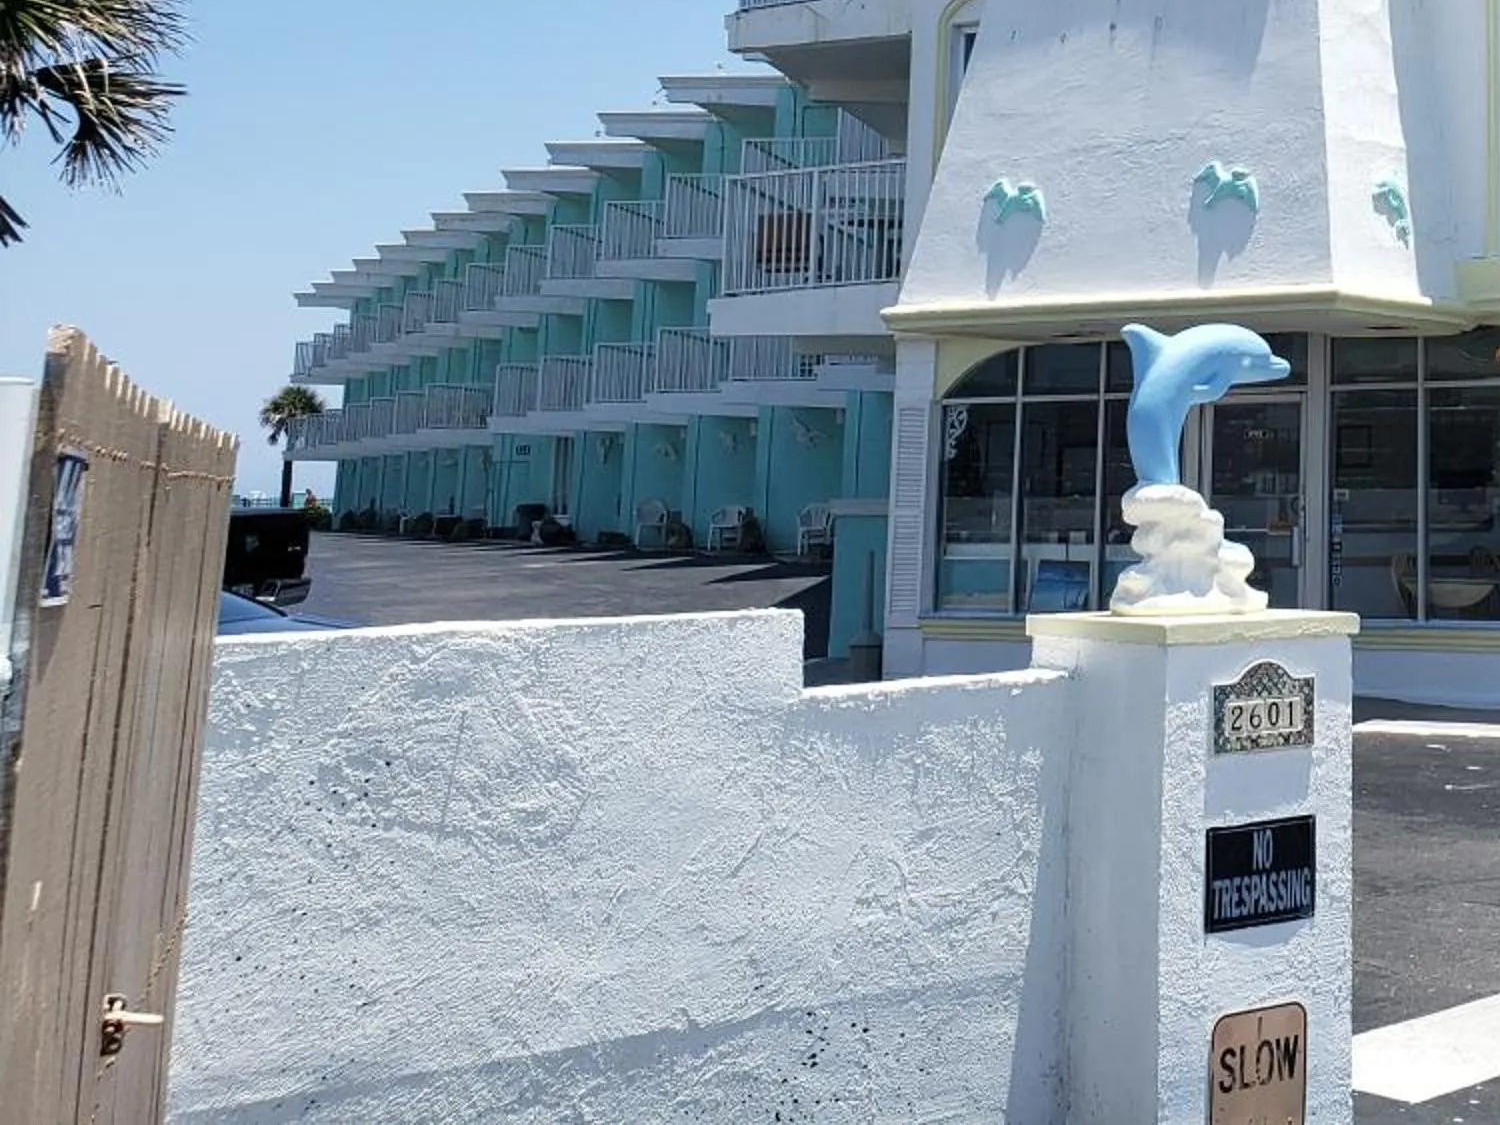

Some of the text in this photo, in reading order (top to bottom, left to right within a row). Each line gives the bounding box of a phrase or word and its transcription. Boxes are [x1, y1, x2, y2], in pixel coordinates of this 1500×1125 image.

[1231, 699, 1297, 732] 2601
[1253, 828, 1273, 870] NO
[1211, 866, 1310, 920] TRESPASSING
[1219, 1035, 1299, 1093] SLOW
